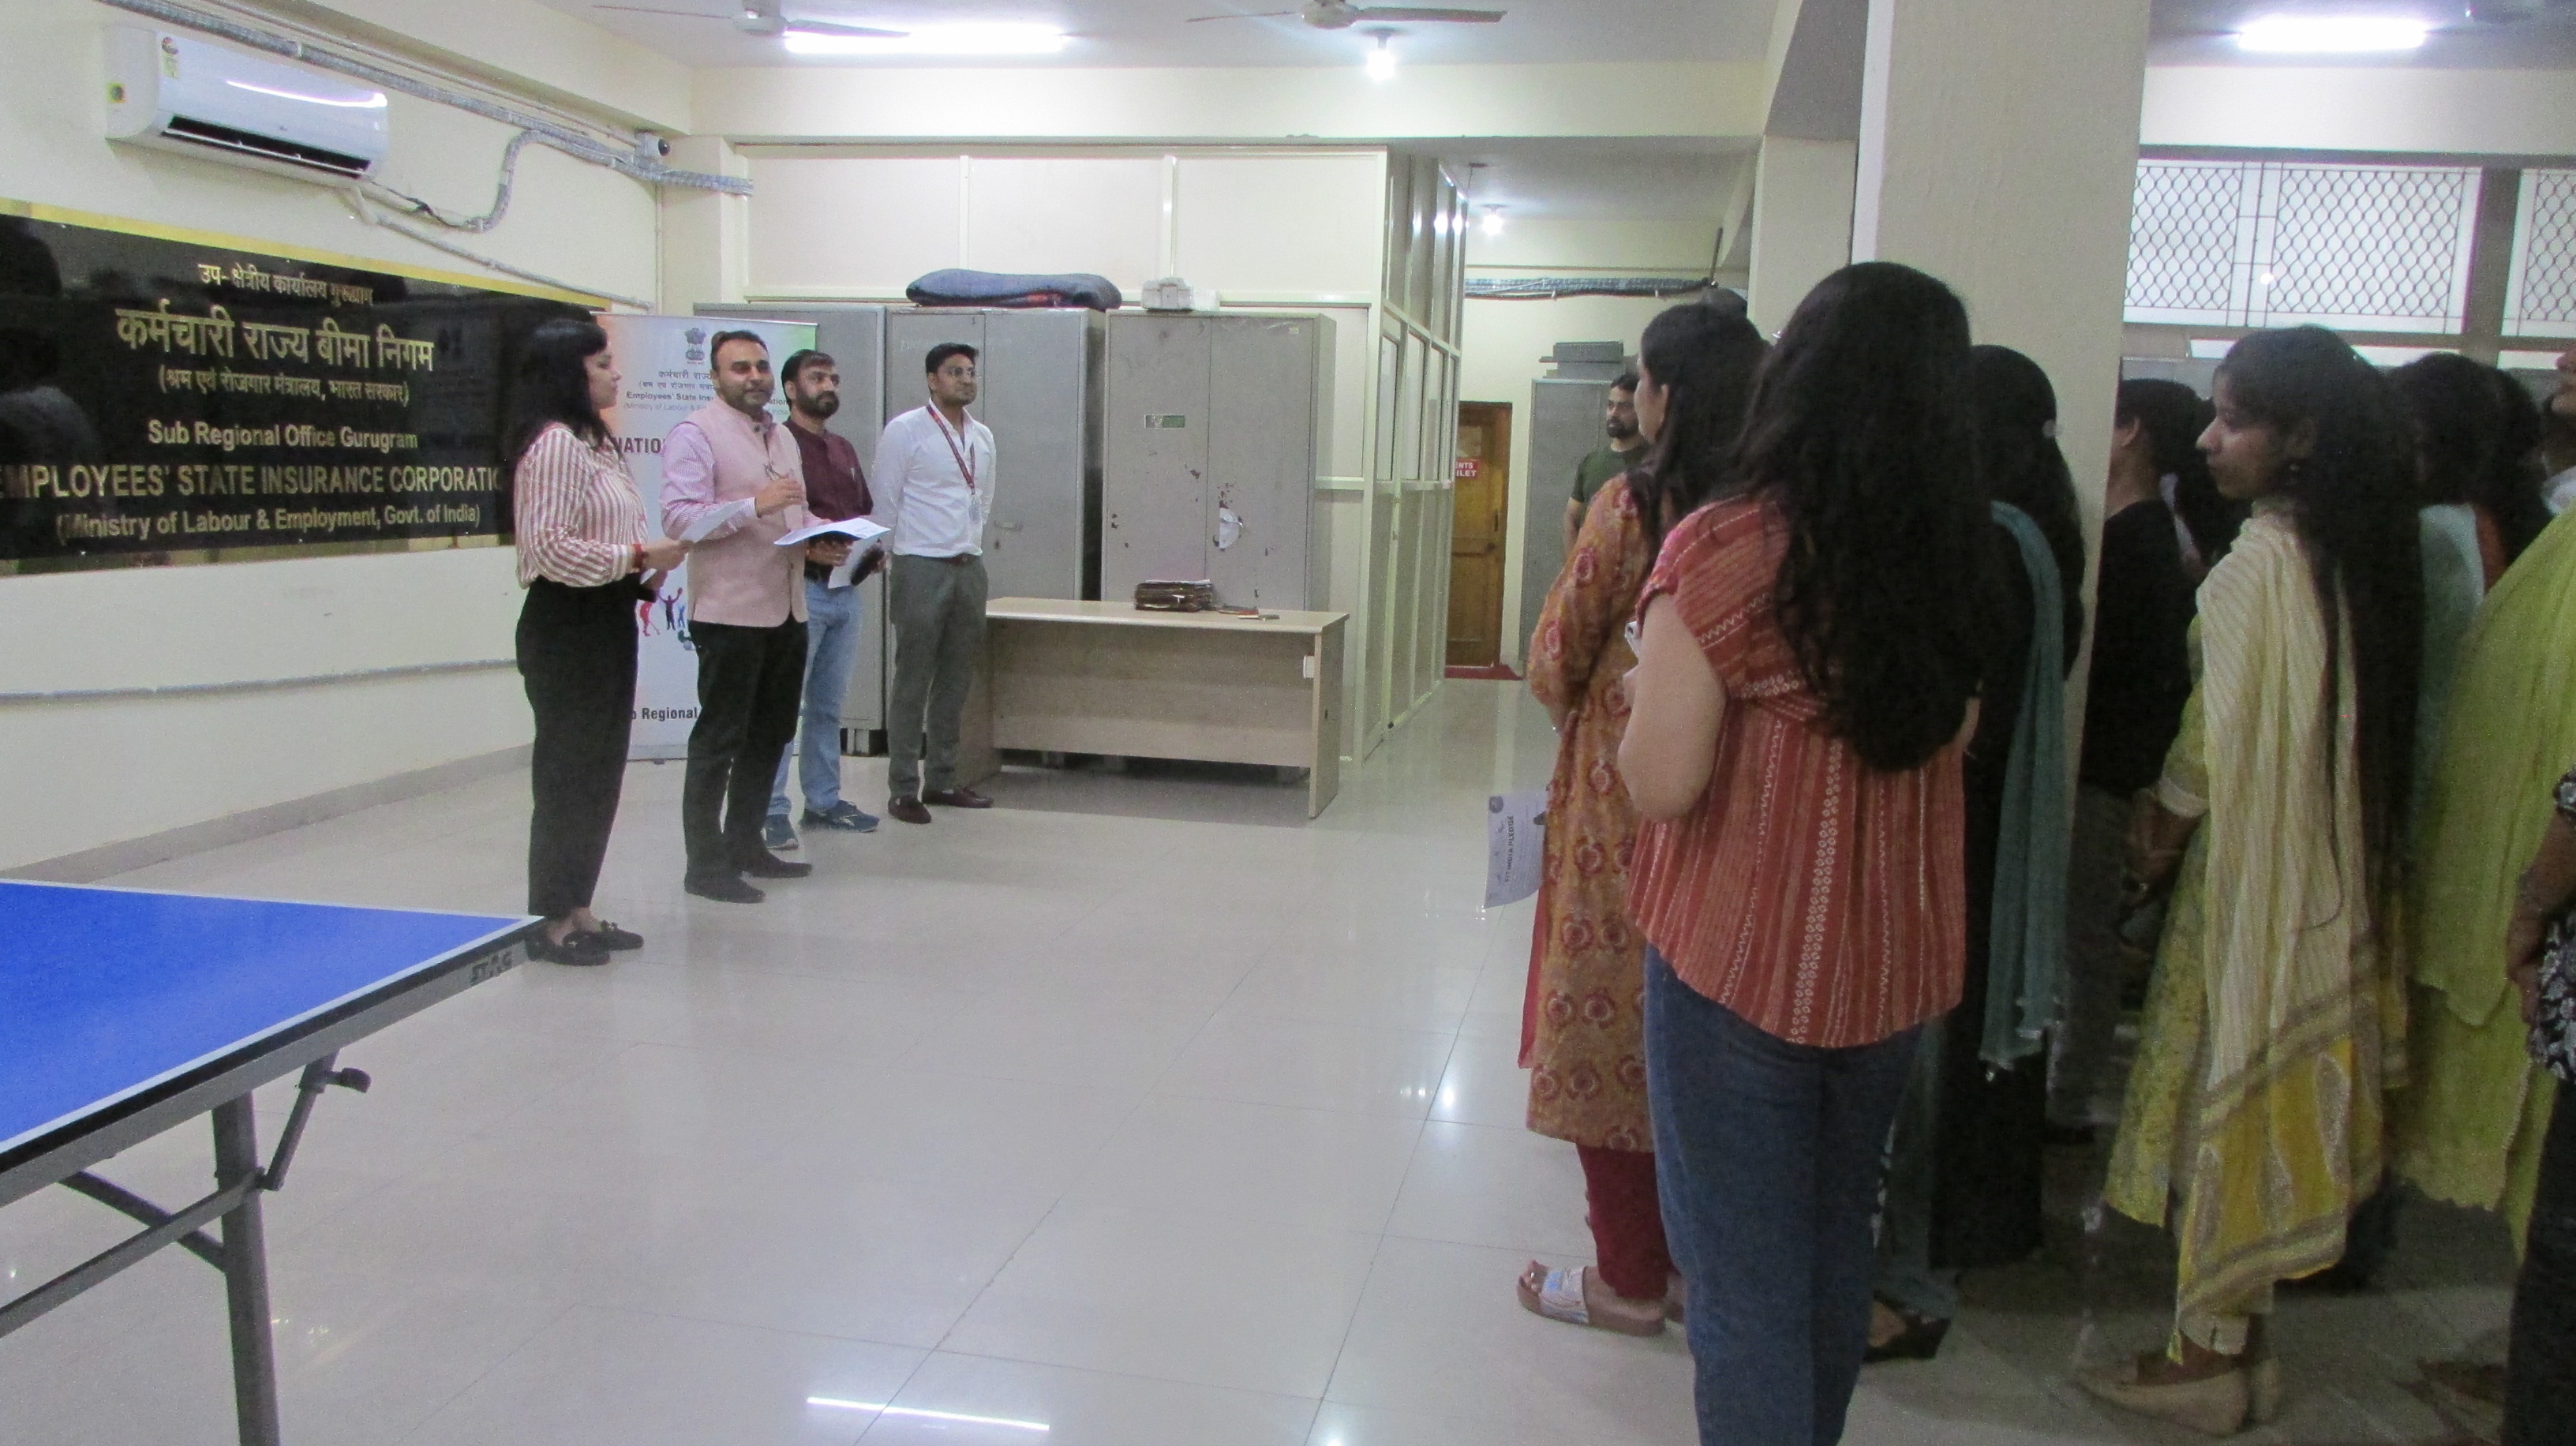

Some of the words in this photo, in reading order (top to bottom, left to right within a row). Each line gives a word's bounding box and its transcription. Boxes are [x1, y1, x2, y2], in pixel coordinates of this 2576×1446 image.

[231, 262, 271, 292] क्षेत्रीय
[273, 272, 328, 299] कार्यालय
[115, 298, 235, 358] कर्मचारी
[242, 321, 310, 364] राज्य
[316, 317, 371, 368] बीमा
[376, 324, 435, 372] निगम
[159, 364, 193, 394] (श्रम
[220, 366, 271, 394] रोजगार
[274, 372, 327, 401] मंत्रालय,
[329, 380, 363, 400] भारत
[365, 382, 410, 407] सरकार)
[627, 391, 675, 401] Employees'
[148, 419, 189, 444] Sub
[195, 421, 280, 451] Regional
[285, 424, 335, 448] Office
[339, 425, 417, 453] Gurugram
[0, 464, 170, 498] MPLOYEES'
[178, 464, 256, 496] STATE
[261, 465, 384, 495] INSURANCE
[56, 512, 151, 546] (Ministry
[157, 511, 178, 534] of
[183, 511, 251, 534] Labour
[256, 508, 270, 530] &
[275, 506, 380, 533] Employment,
[384, 504, 423, 526] Govt.
[426, 504, 440, 523] of
[444, 503, 481, 528] India)
[642, 707, 698, 721] Regional
